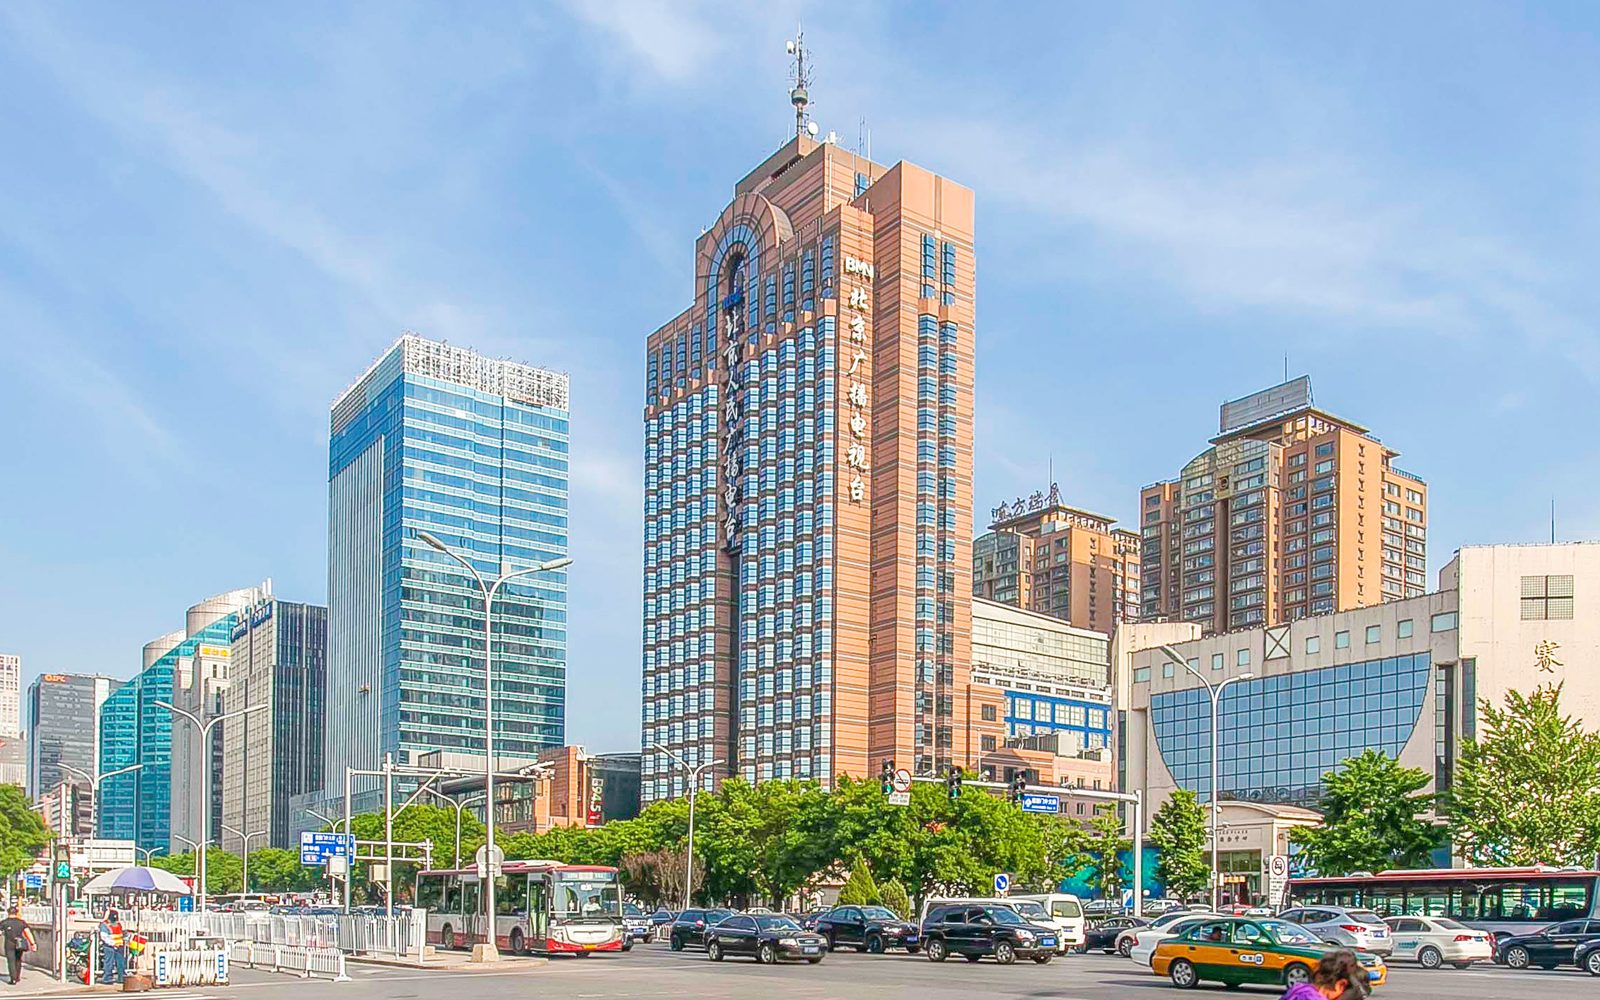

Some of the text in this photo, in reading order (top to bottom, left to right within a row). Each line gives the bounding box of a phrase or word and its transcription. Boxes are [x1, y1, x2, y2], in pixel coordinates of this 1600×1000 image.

[722, 310, 739, 539] 北京人民广播电台
[847, 286, 870, 501] 北京广播电视台
